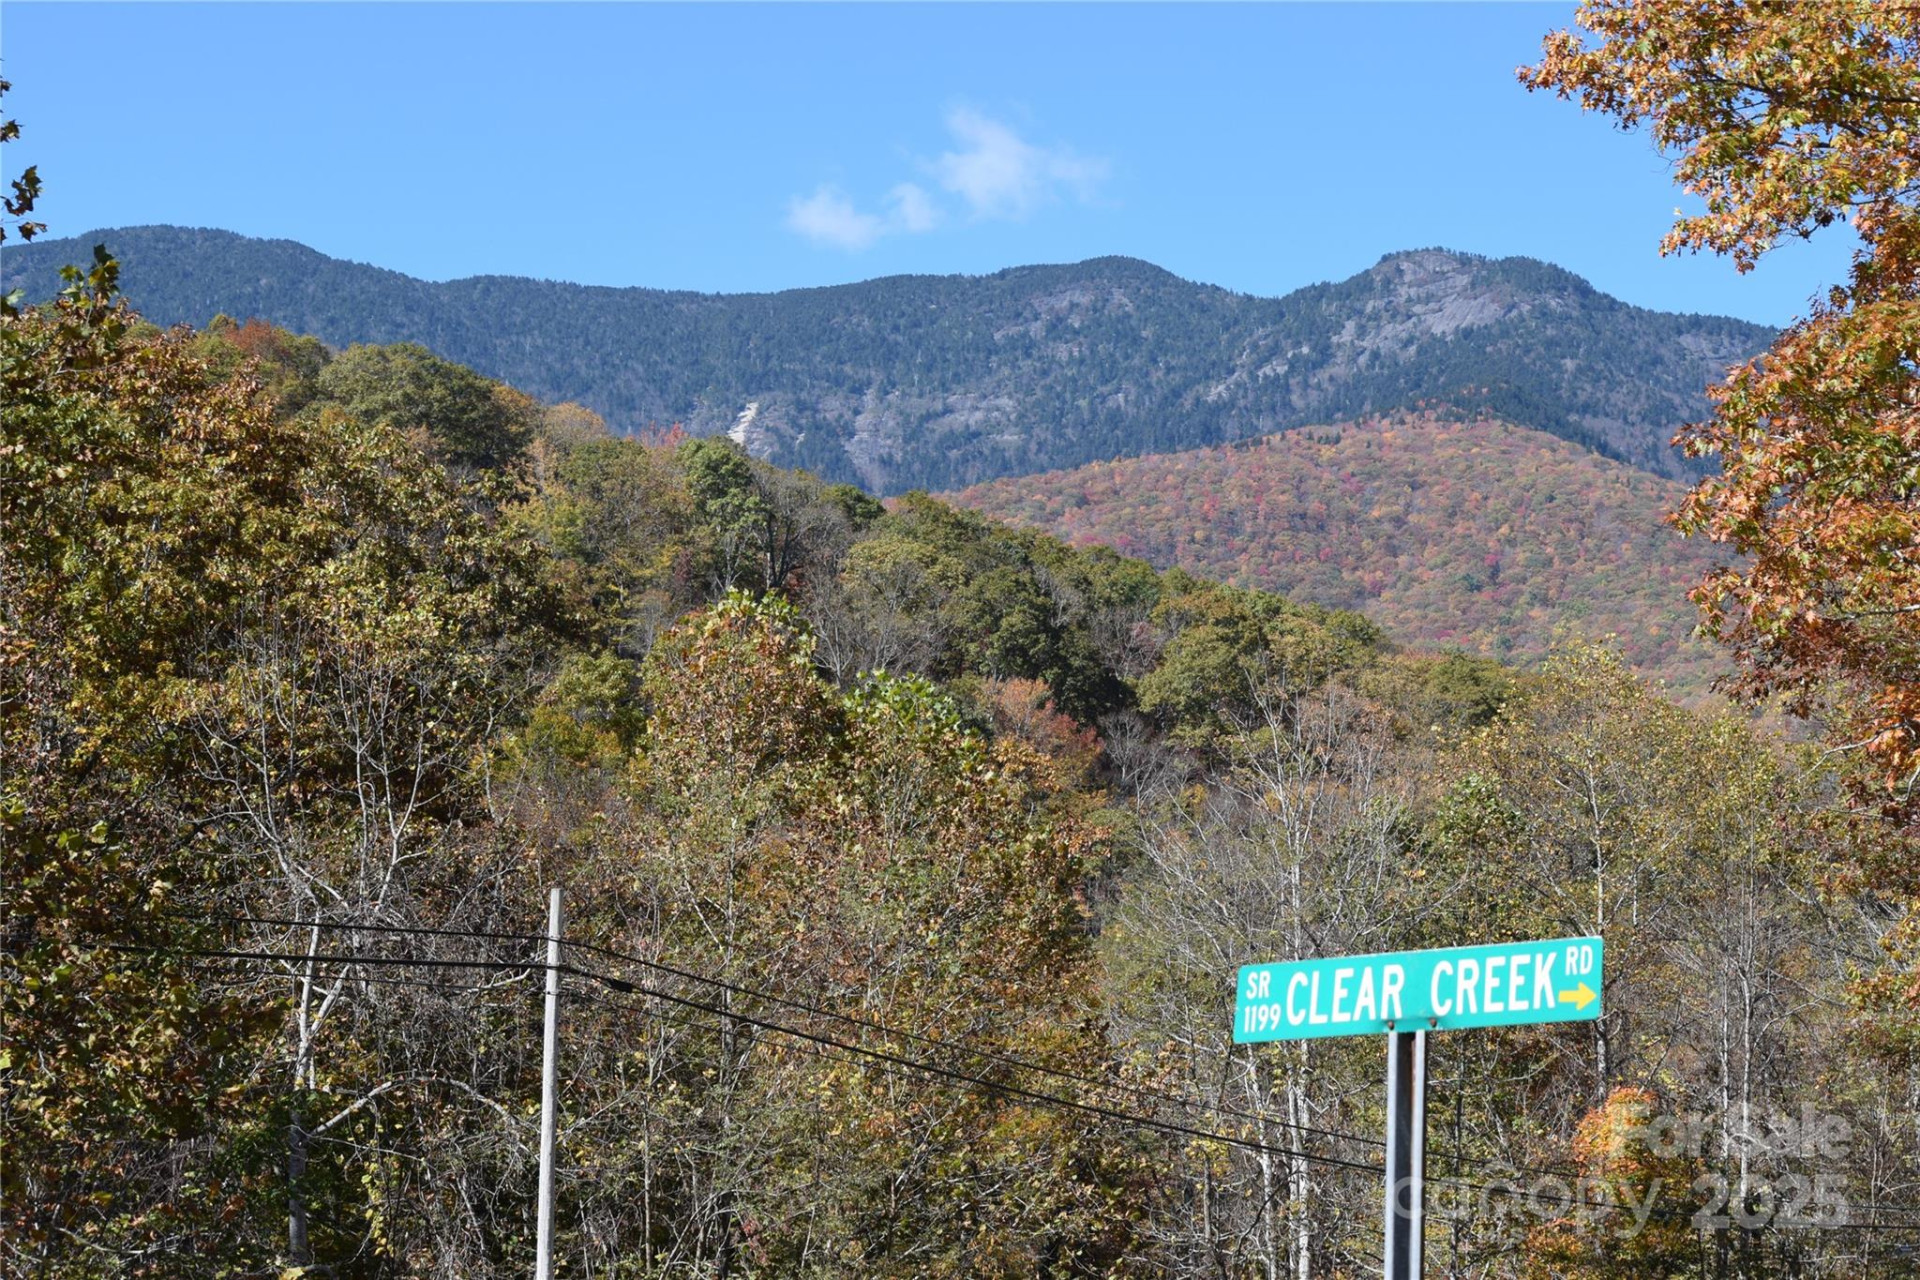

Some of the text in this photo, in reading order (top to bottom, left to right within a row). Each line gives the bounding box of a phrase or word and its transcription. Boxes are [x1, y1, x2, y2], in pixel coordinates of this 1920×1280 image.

[1246, 971, 1271, 999] SR
[1286, 945, 1593, 1026] CLEAR CREEK RD
[1243, 1004, 1281, 1033] 1199
